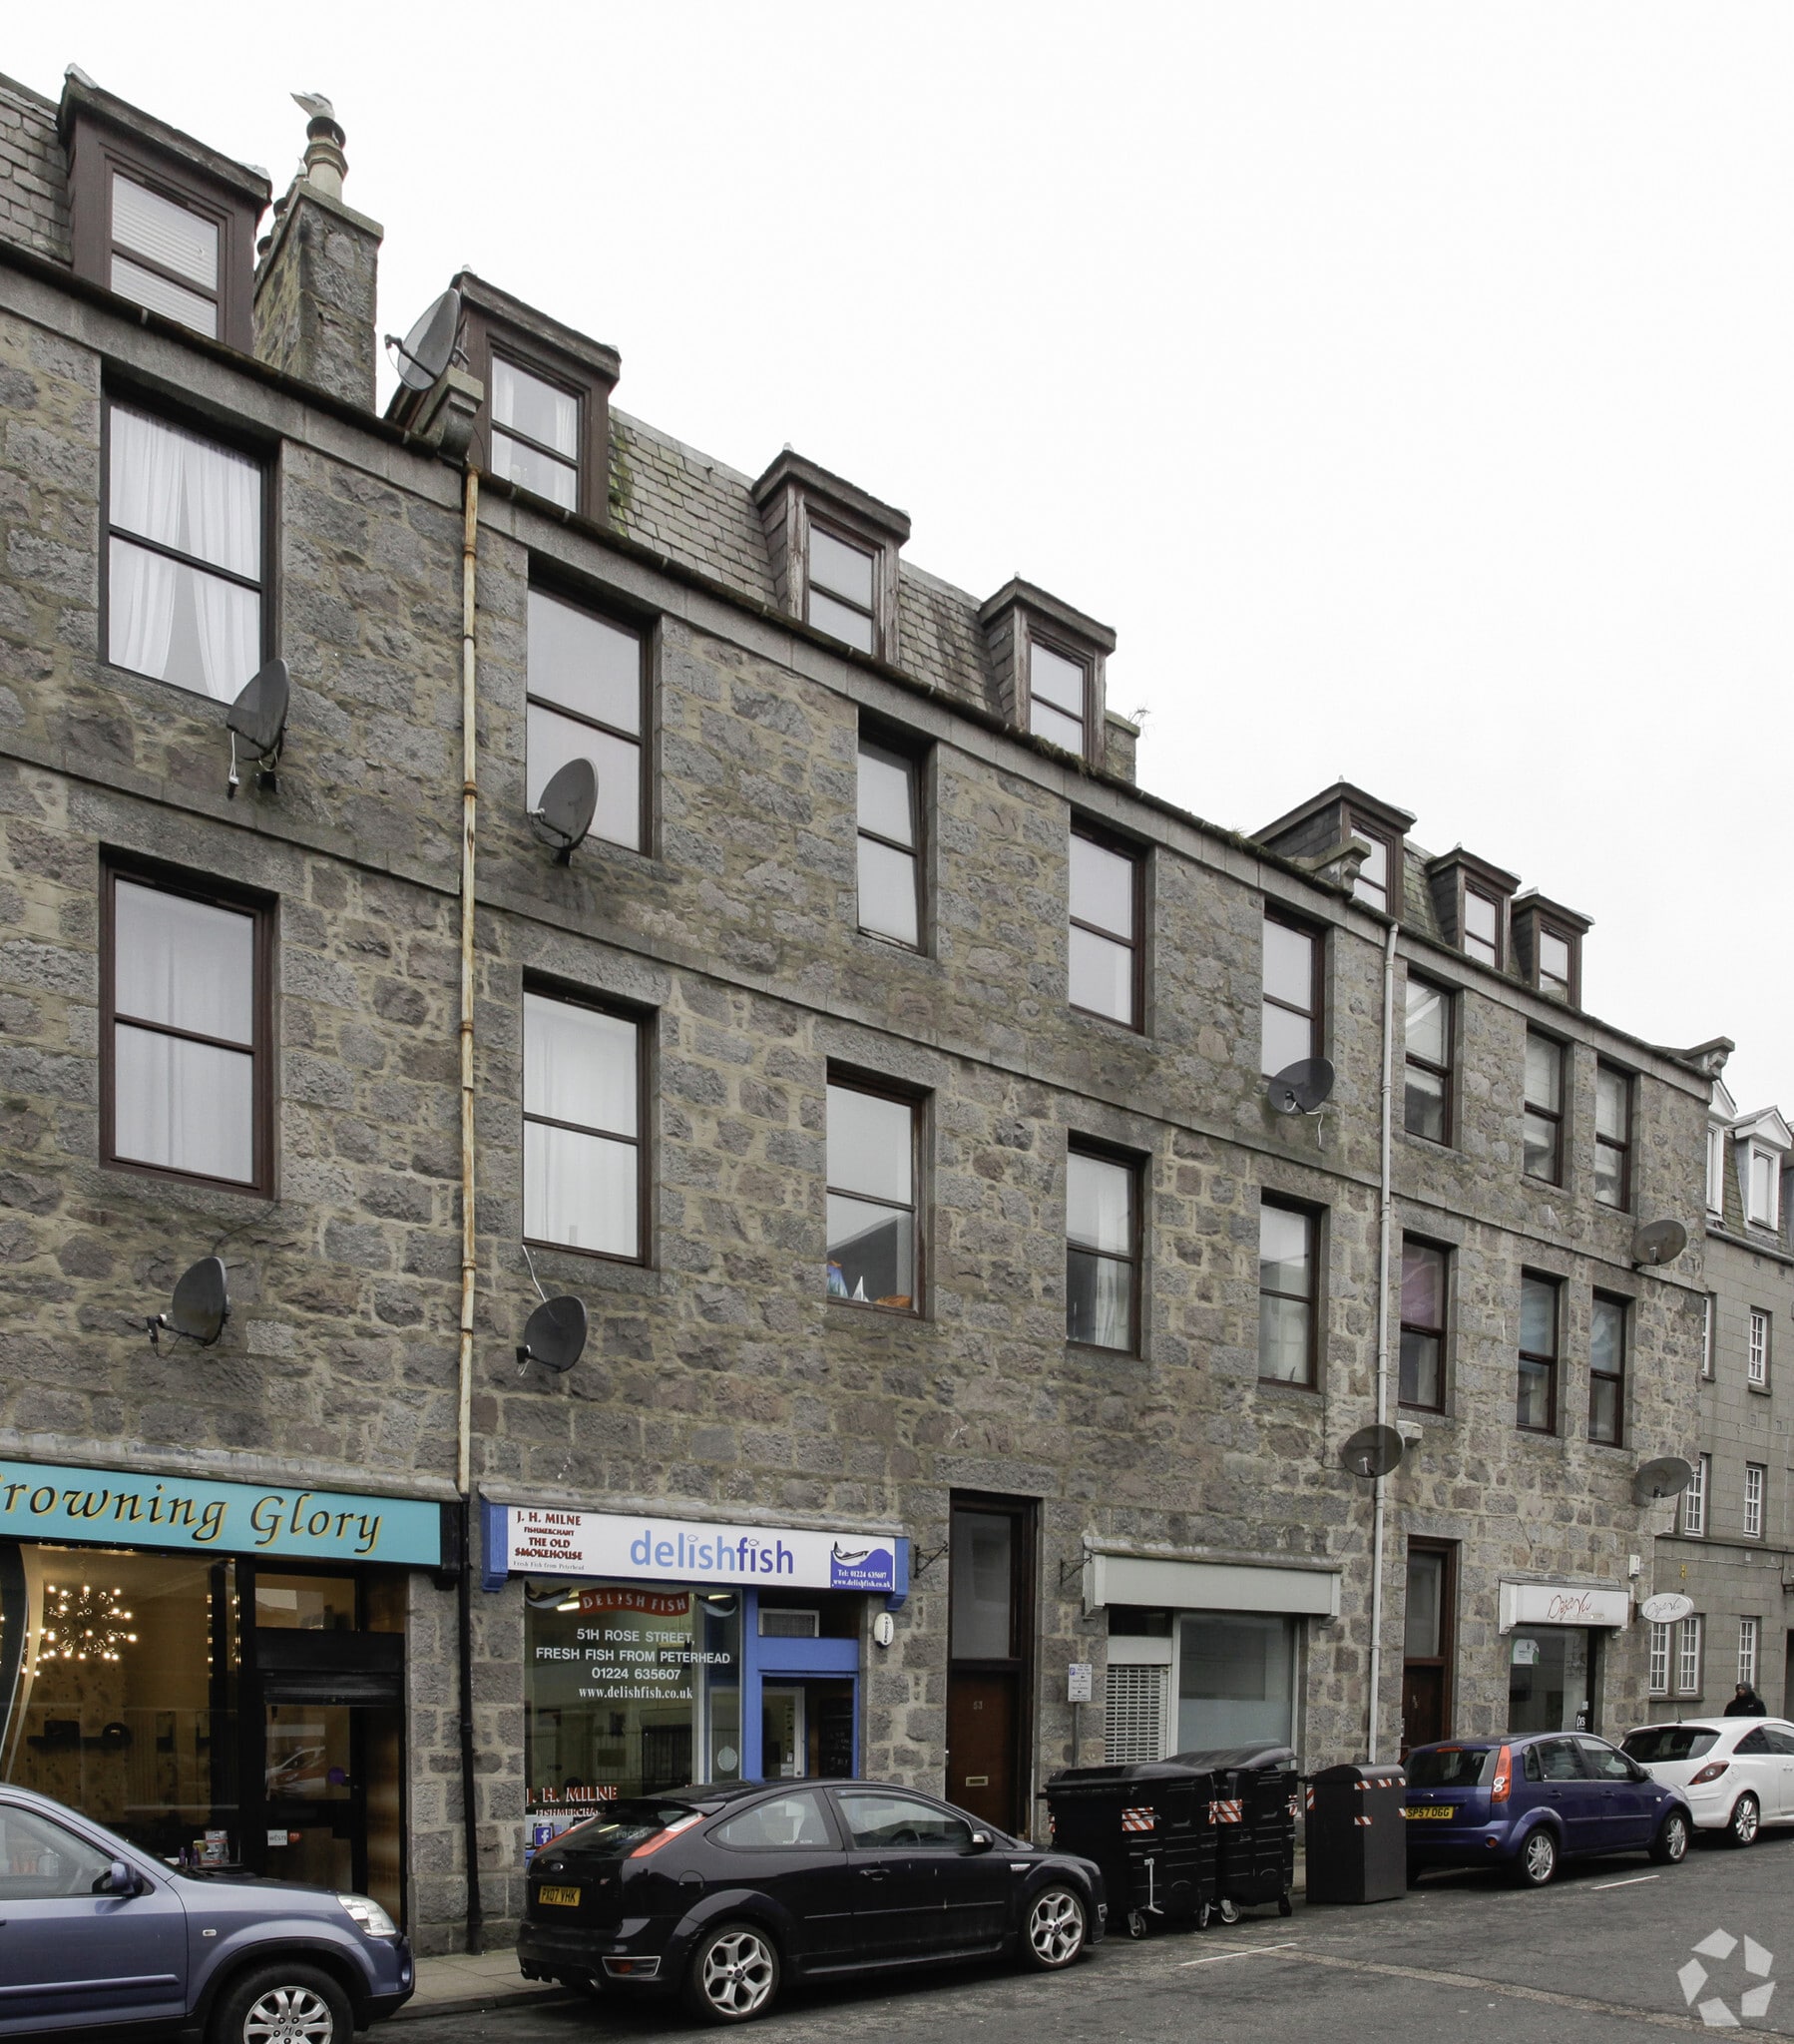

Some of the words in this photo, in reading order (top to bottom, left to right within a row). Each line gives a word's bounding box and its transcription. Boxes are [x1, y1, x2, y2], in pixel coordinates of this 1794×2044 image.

[0, 1483, 229, 1542] rowning
[249, 1493, 383, 1555] Glory
[517, 1511, 525, 1523] J.
[529, 1512, 541, 1523] H.
[545, 1513, 582, 1526] MILNE
[524, 1526, 575, 1536] FISHMERCHANT
[529, 1537, 547, 1547] THE
[550, 1538, 571, 1548] OLD
[515, 1547, 583, 1561] SMOKEHOUSE
[582, 1593, 646, 1609] DELISH
[652, 1598, 686, 1612] FISH
[577, 1628, 600, 1641] 51H
[605, 1629, 640, 1642] ROSE
[645, 1631, 695, 1646] STREET,
[536, 1647, 580, 1661] FRESH
[585, 1648, 615, 1662] FISH
[619, 1650, 656, 1663] FROM
[660, 1651, 730, 1665] PETERHEAD
[592, 1667, 629, 1680] 01224
[635, 1669, 681, 1681] 635607
[579, 1686, 693, 1700] www.delishfish.co.uk
[542, 1787, 561, 1803] H.
[566, 1786, 618, 1801] MILNE
[1408, 1807, 1430, 1817] SP57
